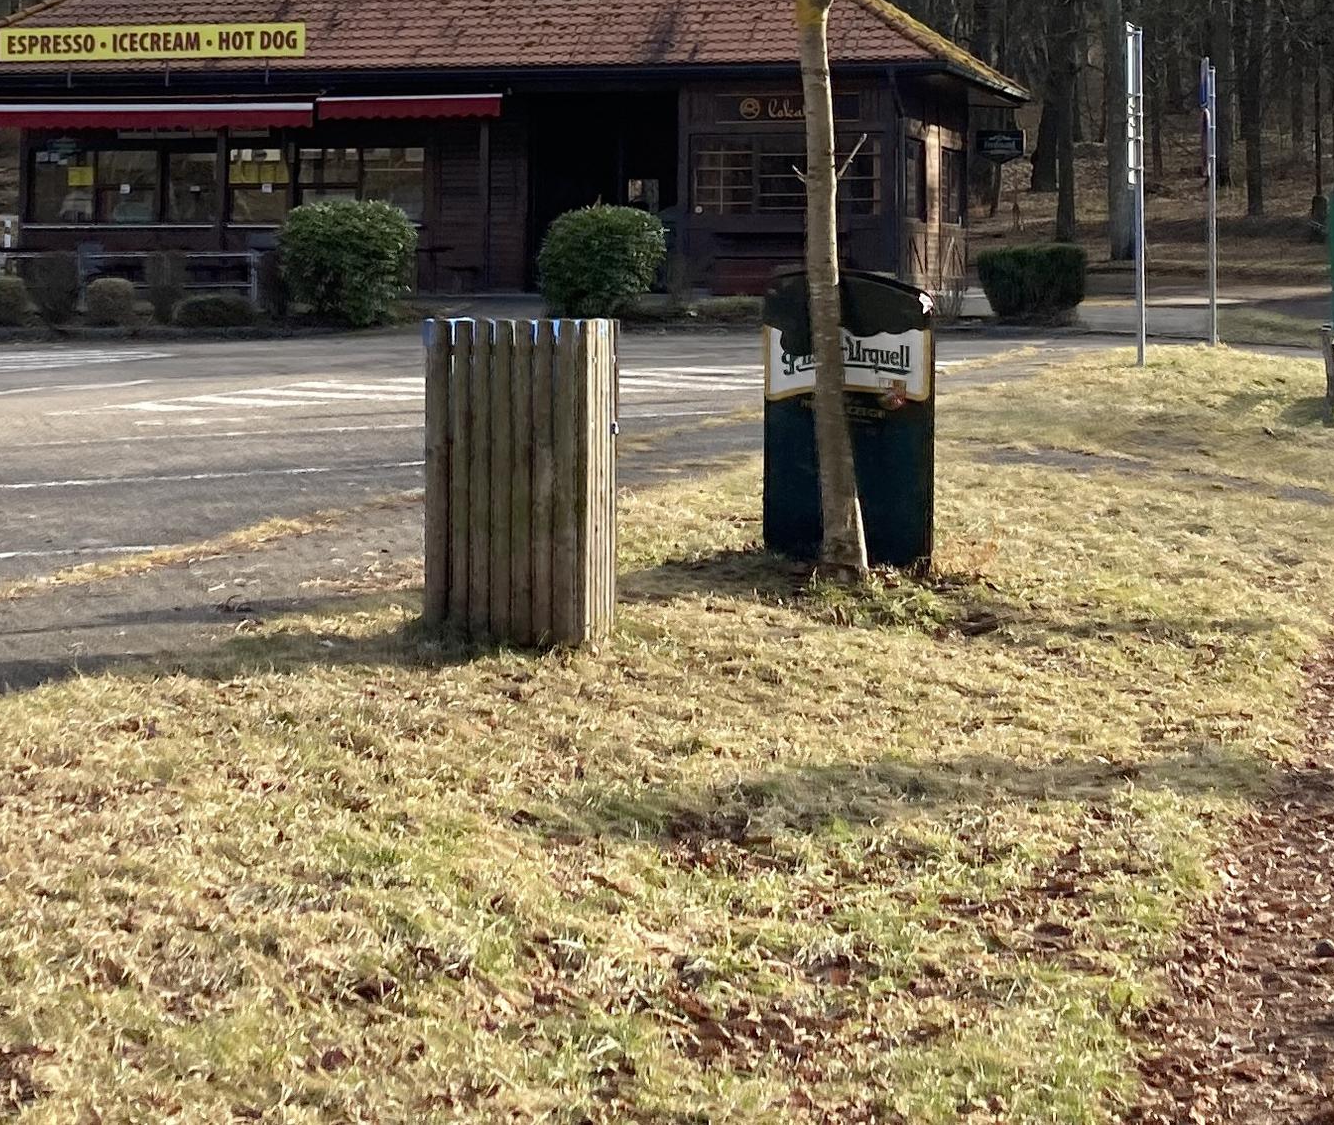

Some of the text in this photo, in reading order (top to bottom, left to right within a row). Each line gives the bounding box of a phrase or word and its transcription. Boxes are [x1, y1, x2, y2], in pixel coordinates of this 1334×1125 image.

[7, 30, 297, 55] ESPRESSO ICECREAM HOT DOG
[845, 336, 911, 372] Urquell
